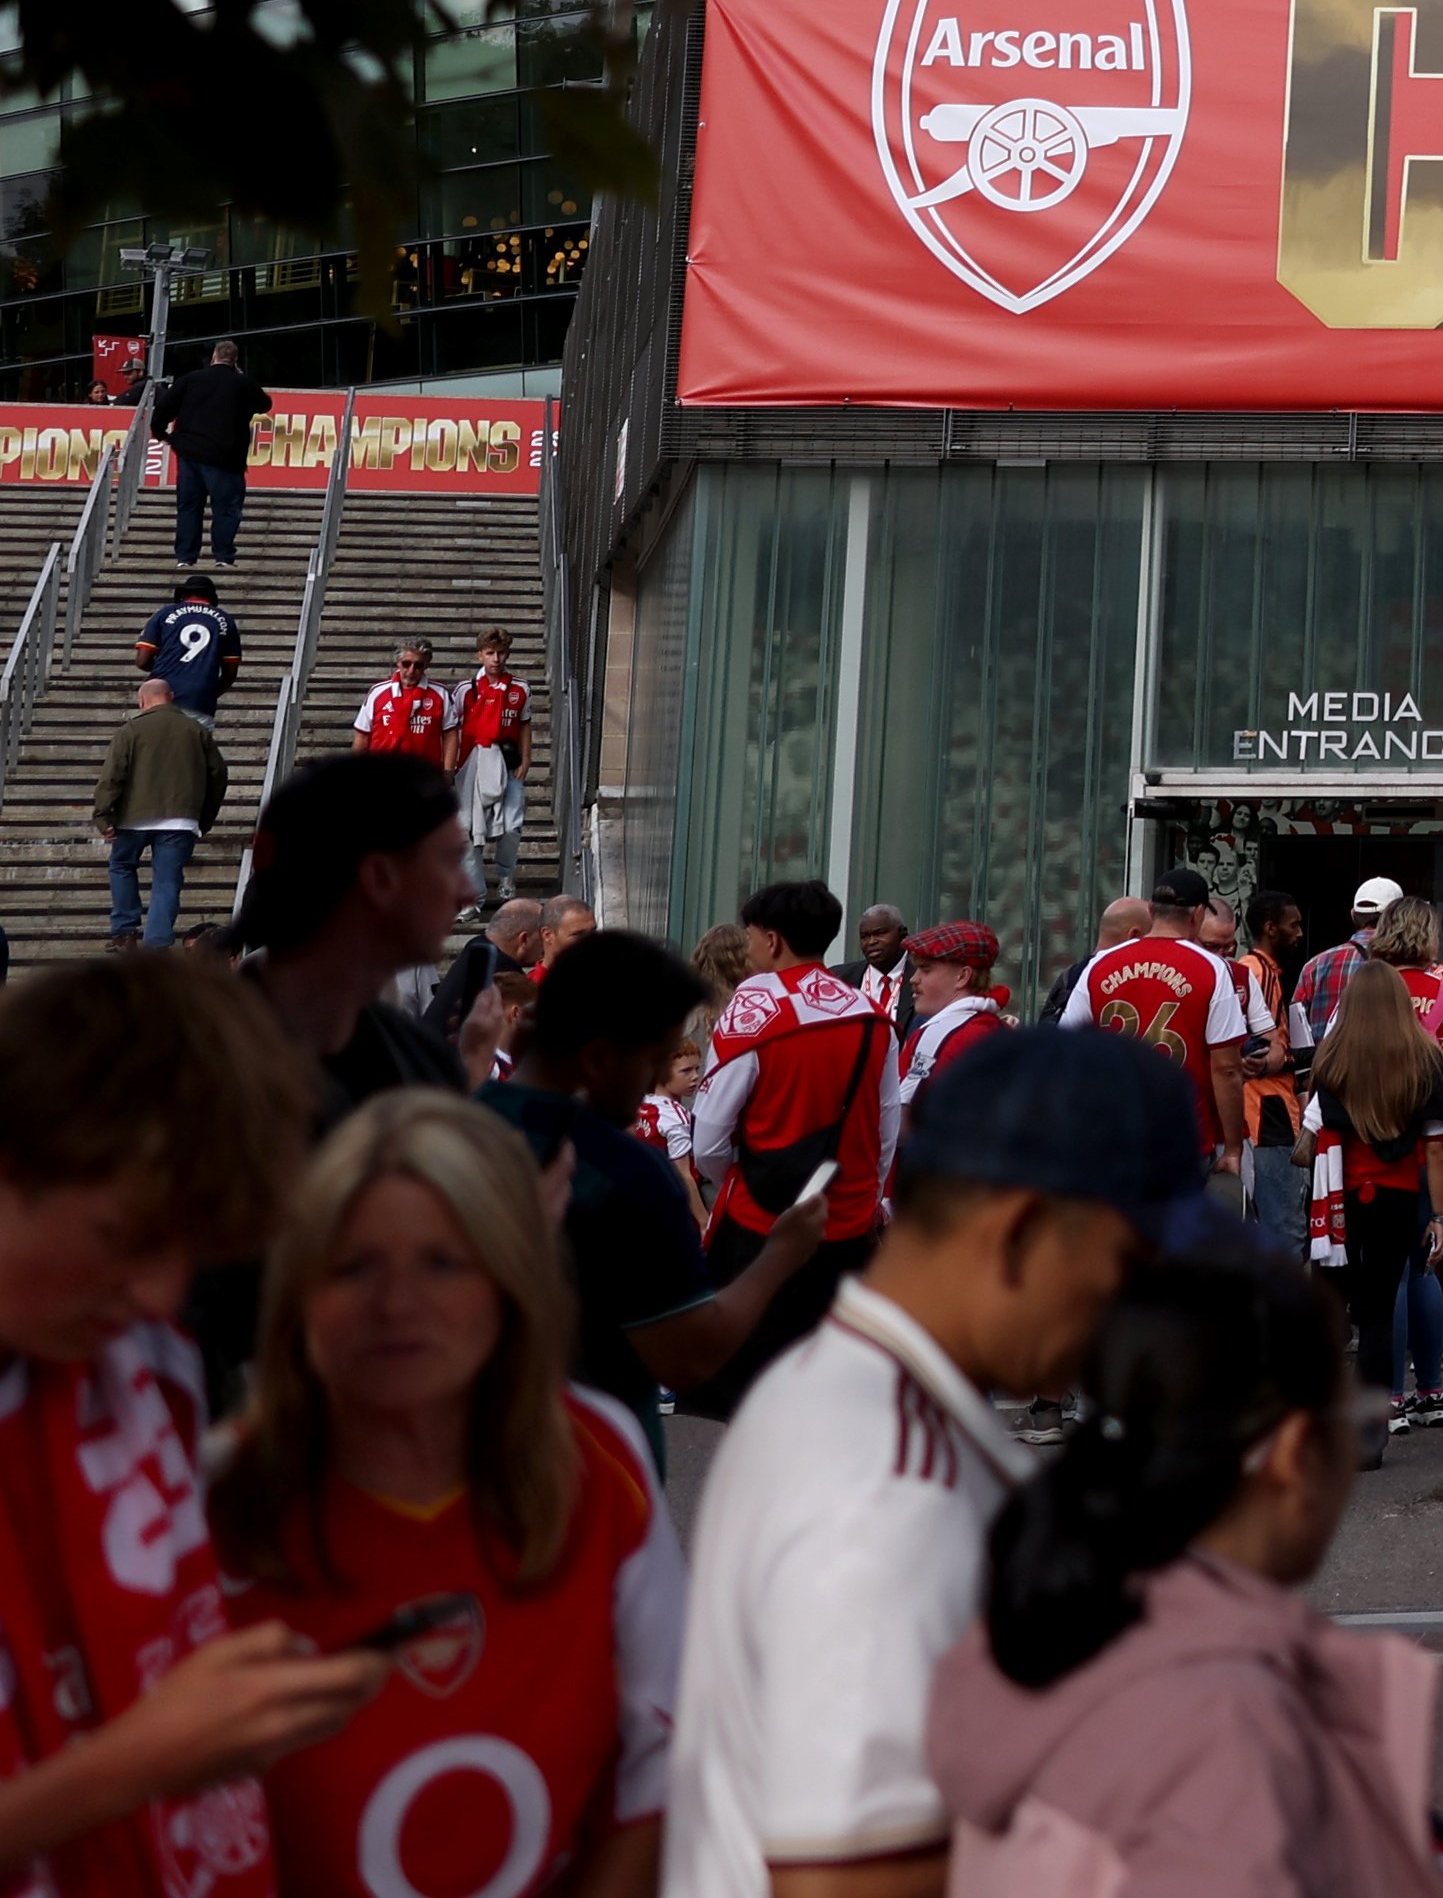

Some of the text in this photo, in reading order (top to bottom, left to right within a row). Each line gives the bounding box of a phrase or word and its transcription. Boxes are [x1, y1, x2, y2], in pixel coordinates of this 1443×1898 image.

[920, 16, 1146, 72] Arsenal
[179, 623, 211, 662] 9
[1287, 691, 1423, 722] MEDIA
[1100, 962, 1193, 998] CHAMPIONS
